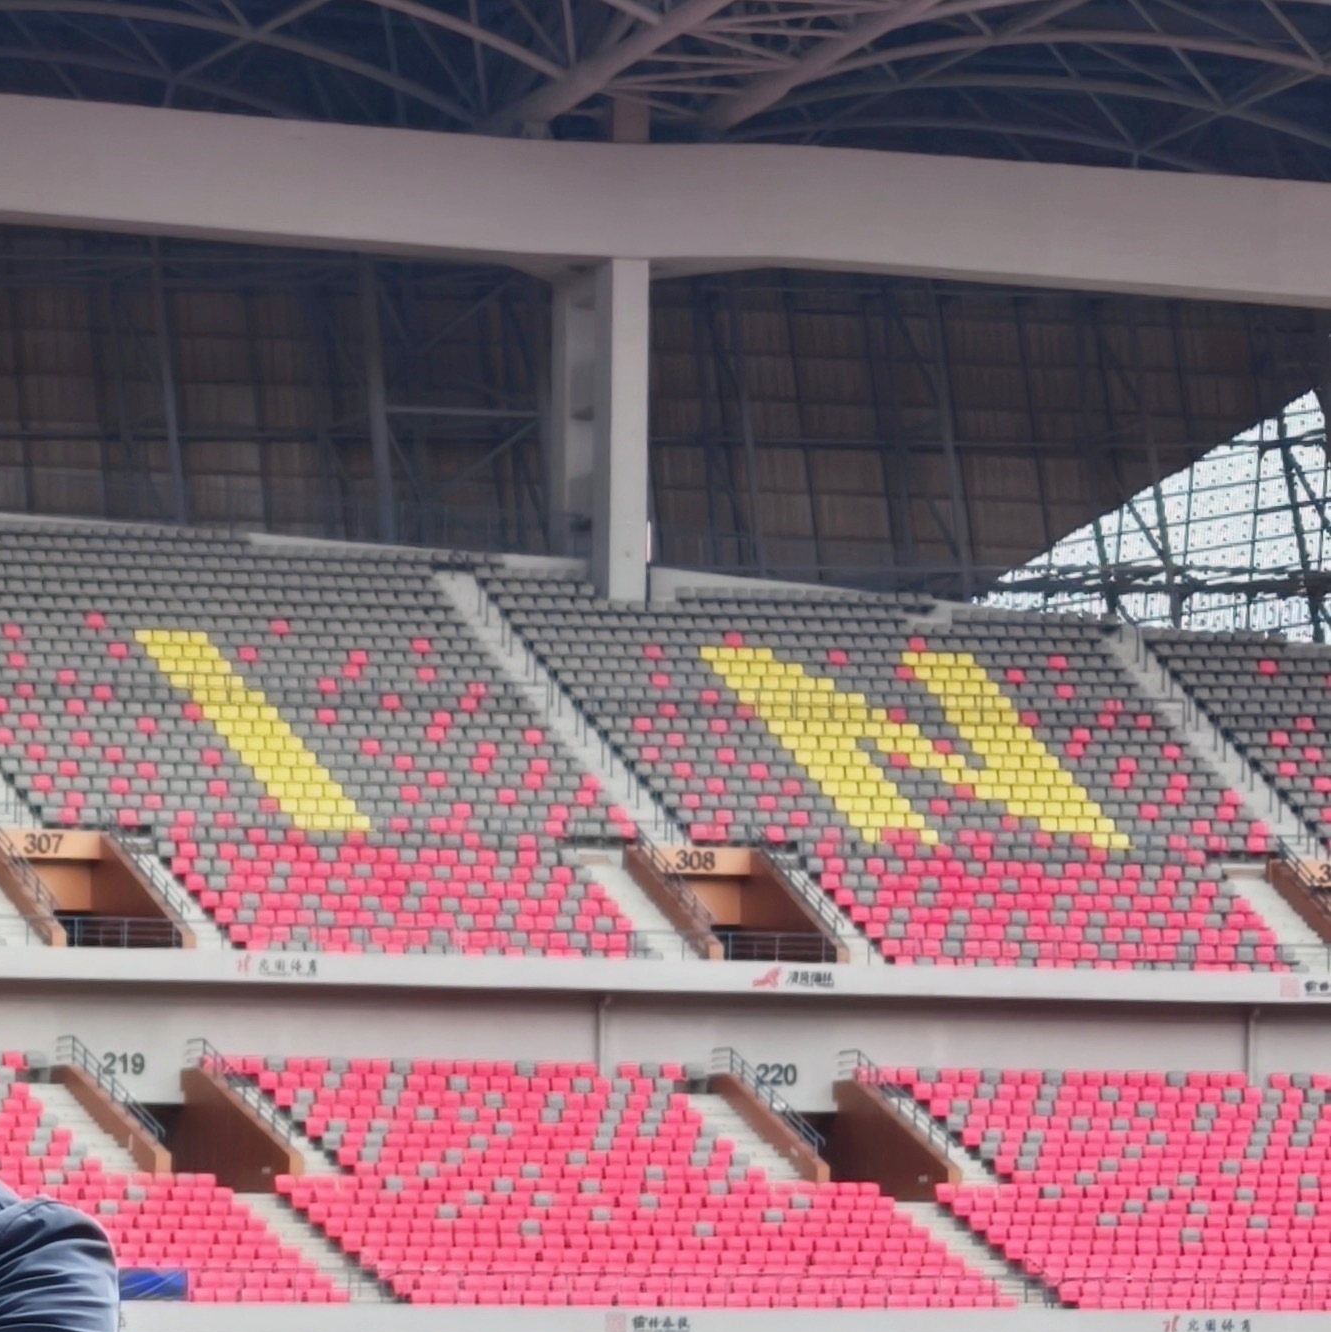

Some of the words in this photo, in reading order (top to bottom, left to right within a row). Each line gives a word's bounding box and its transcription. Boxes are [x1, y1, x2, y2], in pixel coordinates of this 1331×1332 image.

[23, 833, 65, 856] 307
[675, 849, 717, 873] 308
[101, 1051, 146, 1077] 219
[755, 1063, 798, 1088] 220
